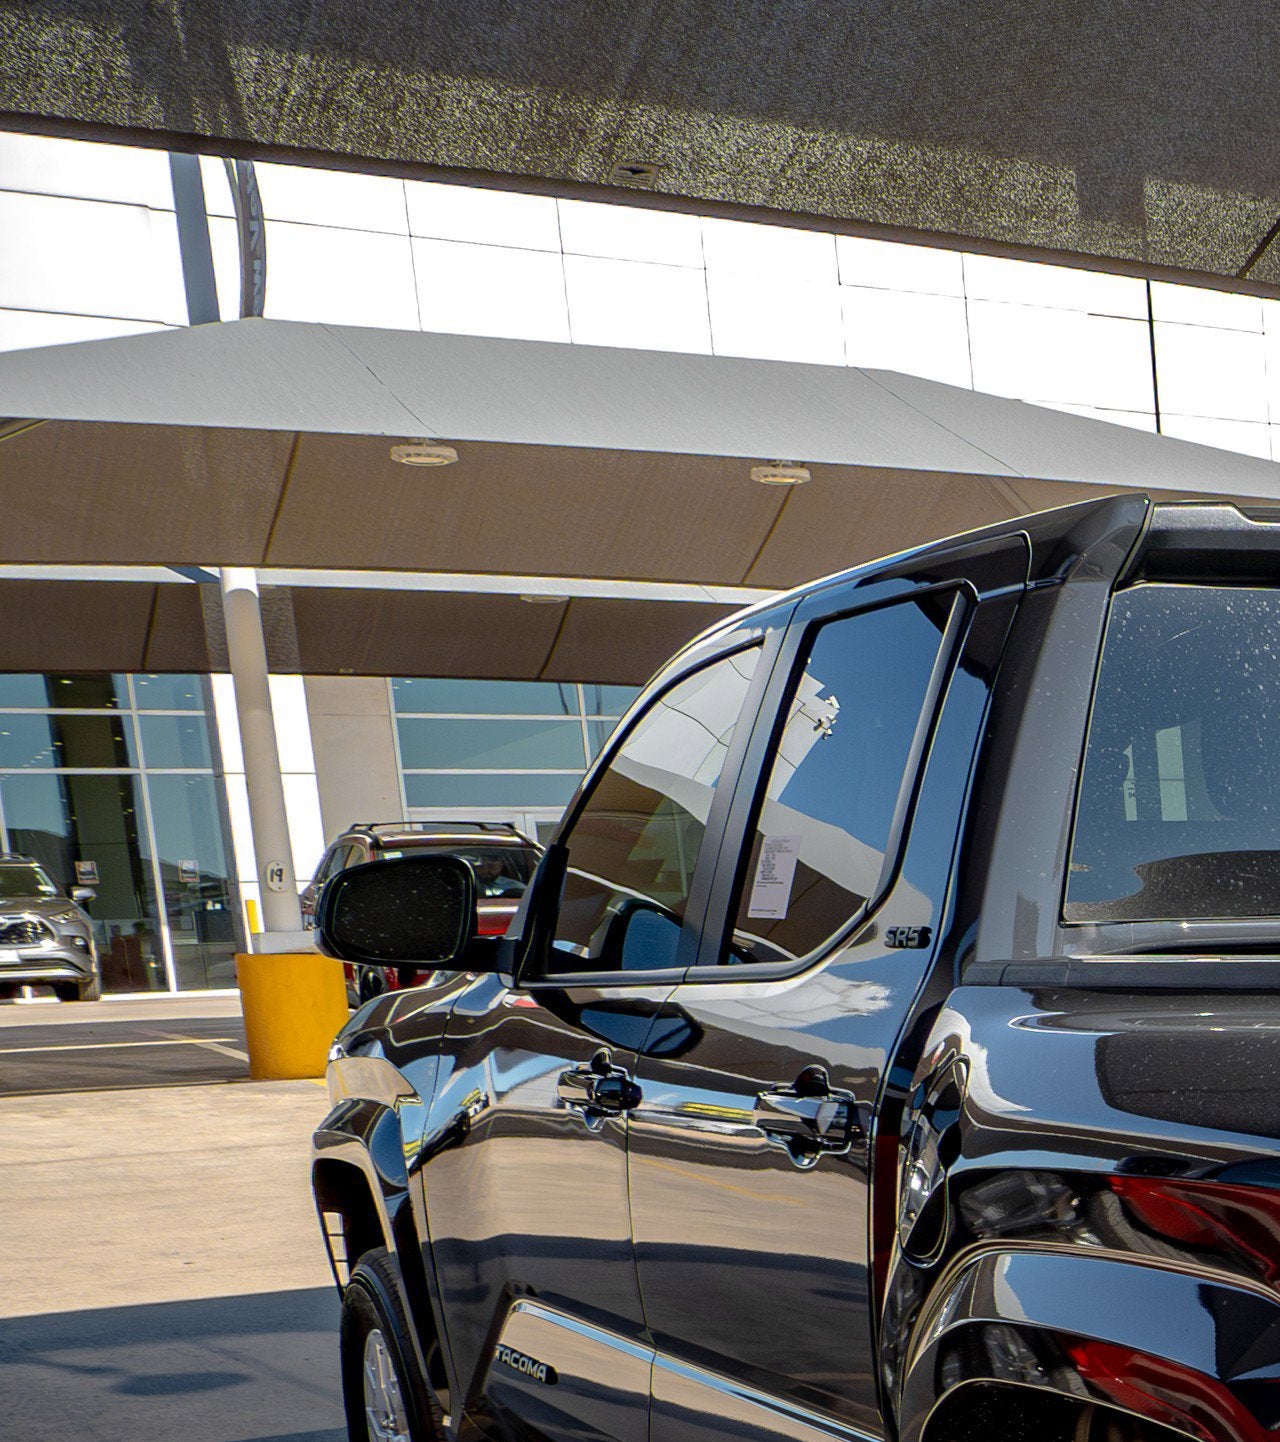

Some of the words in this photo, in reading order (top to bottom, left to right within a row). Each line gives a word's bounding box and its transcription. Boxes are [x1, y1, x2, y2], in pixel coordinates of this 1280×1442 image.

[270, 868, 284, 882] 19
[884, 926, 931, 949] SR5
[495, 1344, 548, 1382] TACOMA
